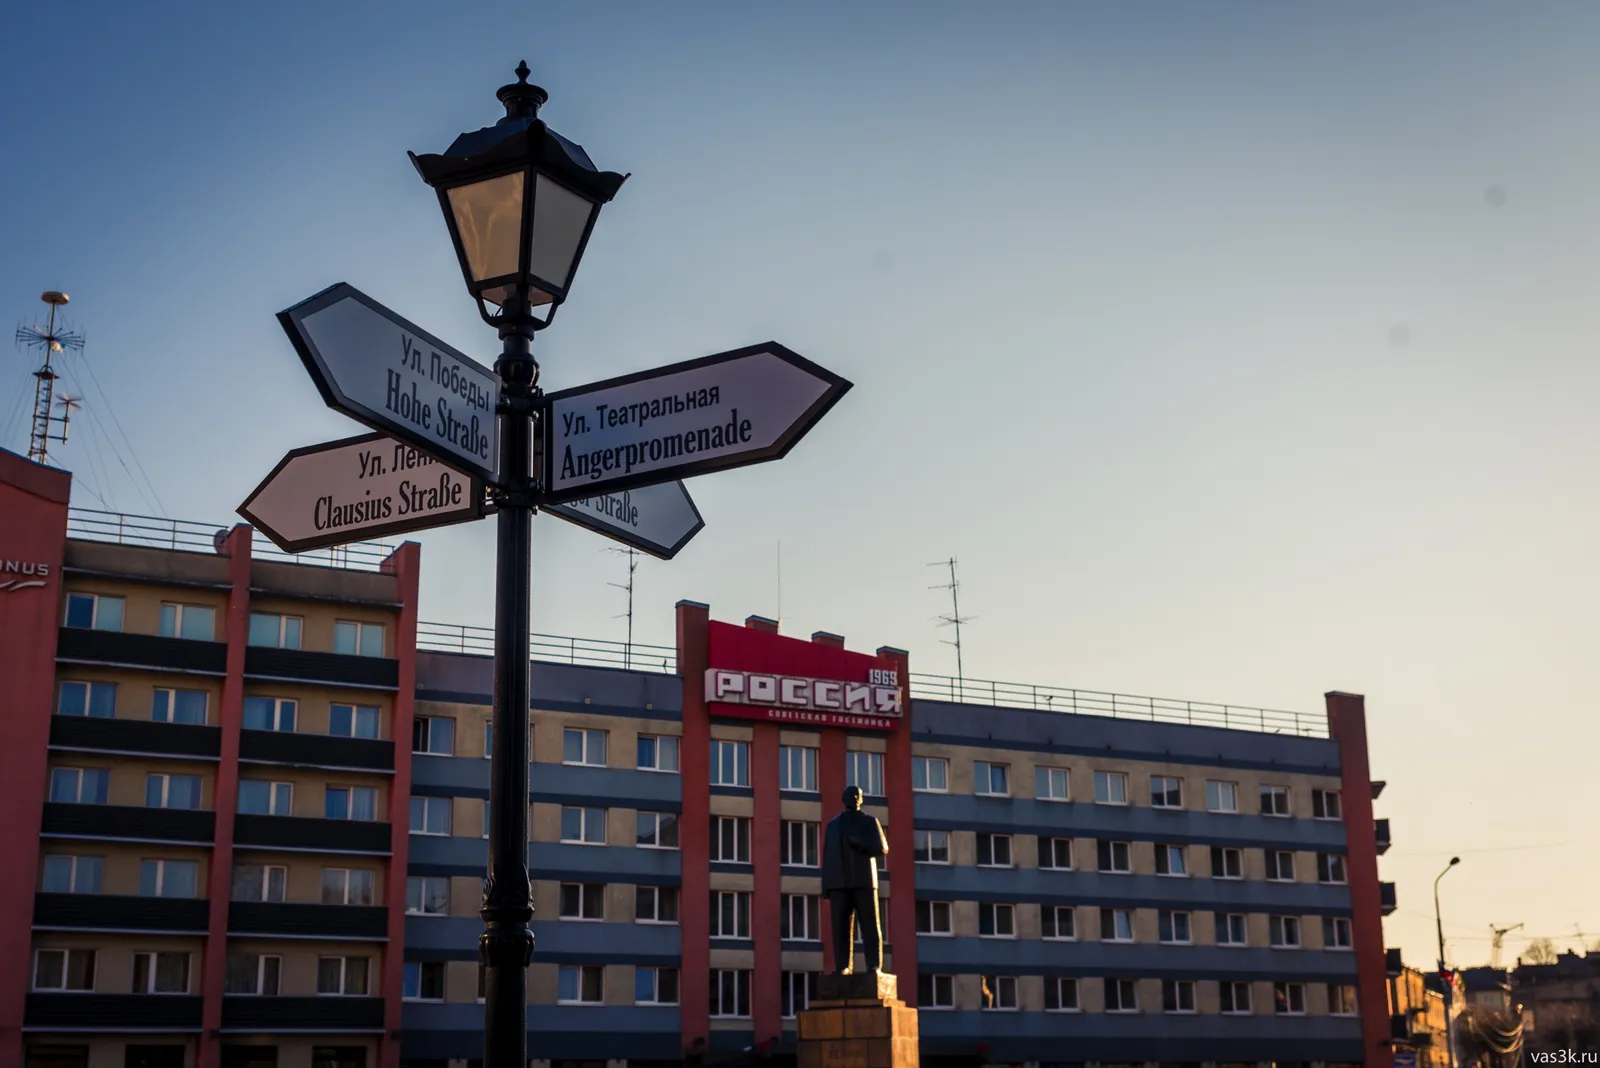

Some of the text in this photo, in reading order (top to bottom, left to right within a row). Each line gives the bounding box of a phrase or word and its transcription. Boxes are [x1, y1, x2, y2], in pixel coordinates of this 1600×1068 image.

[401, 333, 489, 412] Ул. Победы
[385, 367, 488, 460] Hohe Straße
[562, 385, 720, 437] Ул. Театральная
[358, 450, 386, 479] Ул.
[559, 407, 753, 481] Angerpromenade
[314, 472, 462, 531] Clausius Straße
[714, 671, 902, 714] РОССИЯ
[869, 668, 898, 686] 1969
